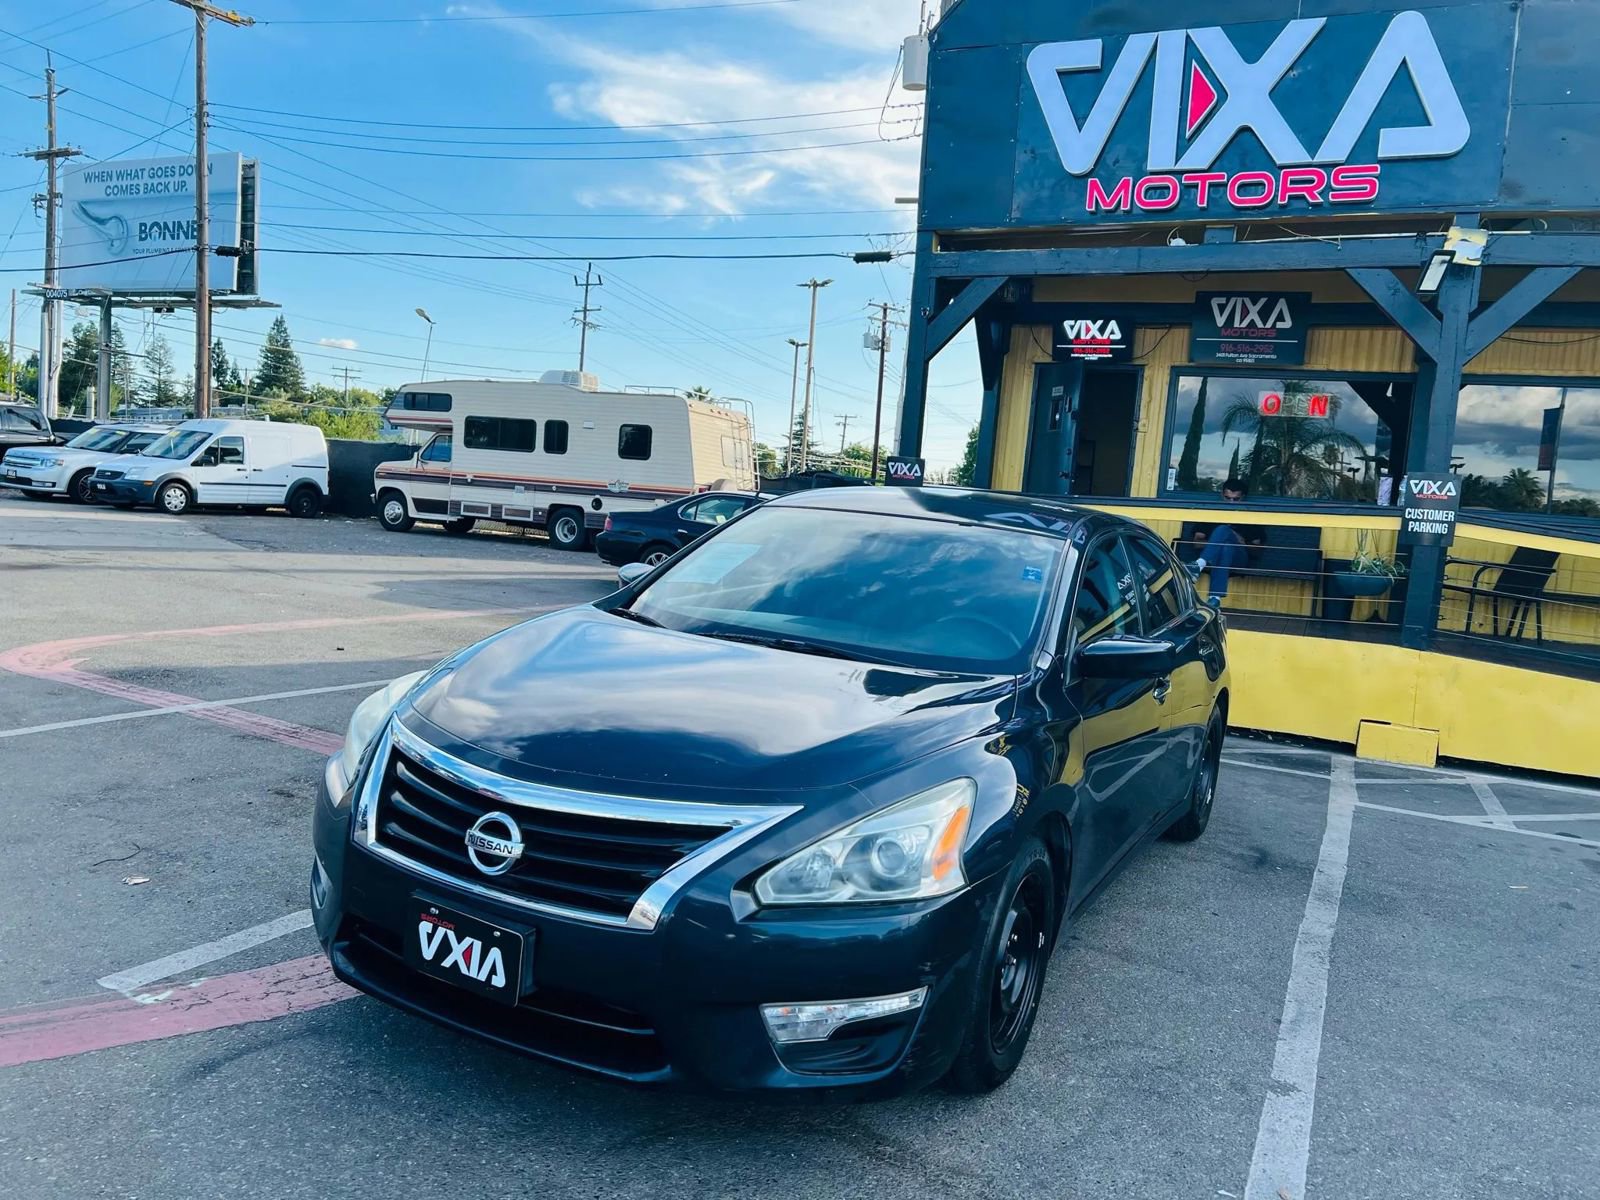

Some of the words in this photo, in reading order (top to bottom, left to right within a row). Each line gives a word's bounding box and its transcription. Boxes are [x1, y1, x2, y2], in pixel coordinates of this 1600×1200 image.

[1026, 11, 1470, 175] VIXA
[83, 170, 113, 184] WHEN
[115, 168, 146, 181] WHAT
[148, 165, 176, 179] GOES
[178, 162, 213, 177] DON
[104, 183, 140, 197] COMES
[142, 181, 170, 194] BACK
[173, 180, 188, 193] UP.
[1085, 163, 1381, 213] MOTORS
[1211, 297, 1293, 329] VIXA
[1063, 319, 1122, 340] VIXA
[1221, 328, 1277, 337] MOTORS
[887, 461, 922, 477] VIXA
[1409, 479, 1457, 497] VIXA
[1404, 507, 1455, 522] CUSTOMER
[1407, 520, 1449, 535] PARKING
[468, 831, 514, 855] NISSAN
